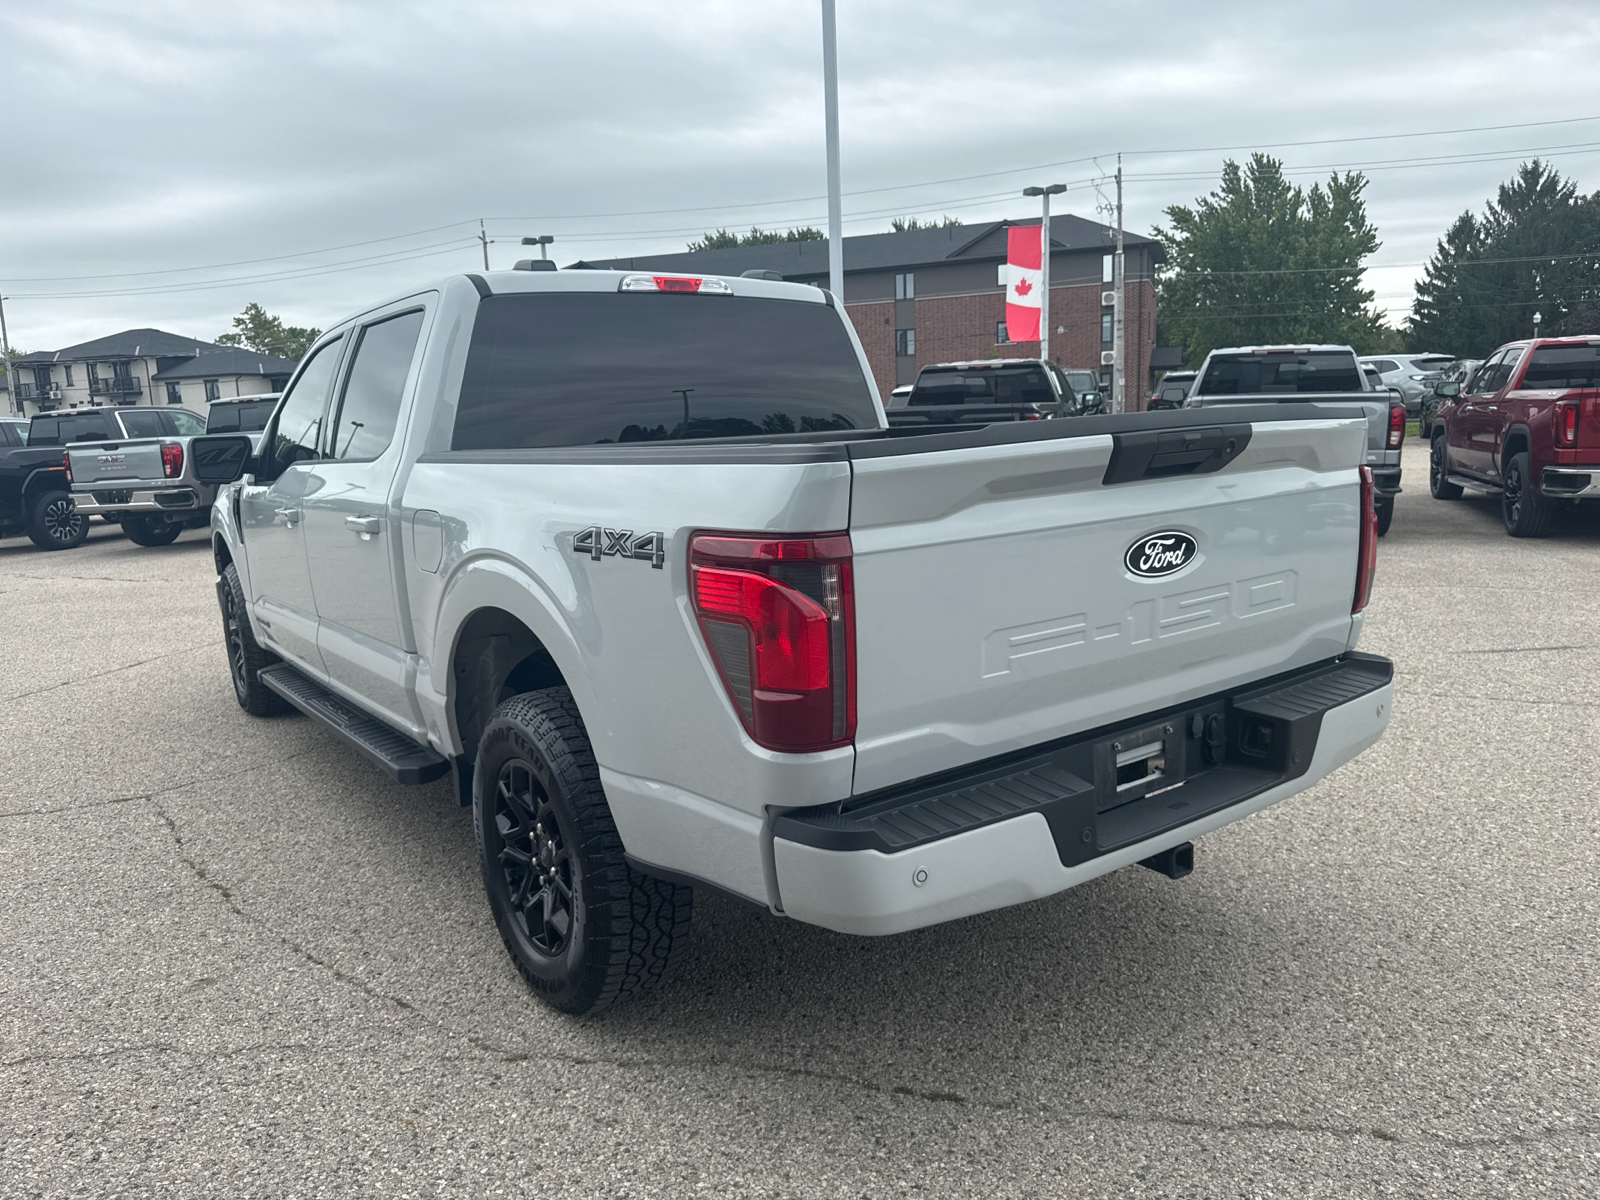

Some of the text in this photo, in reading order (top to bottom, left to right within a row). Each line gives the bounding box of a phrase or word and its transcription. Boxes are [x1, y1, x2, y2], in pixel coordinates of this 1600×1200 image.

[97, 454, 126, 464] GMC
[1139, 537, 1187, 571] Ford
[981, 568, 1298, 679] F-150
